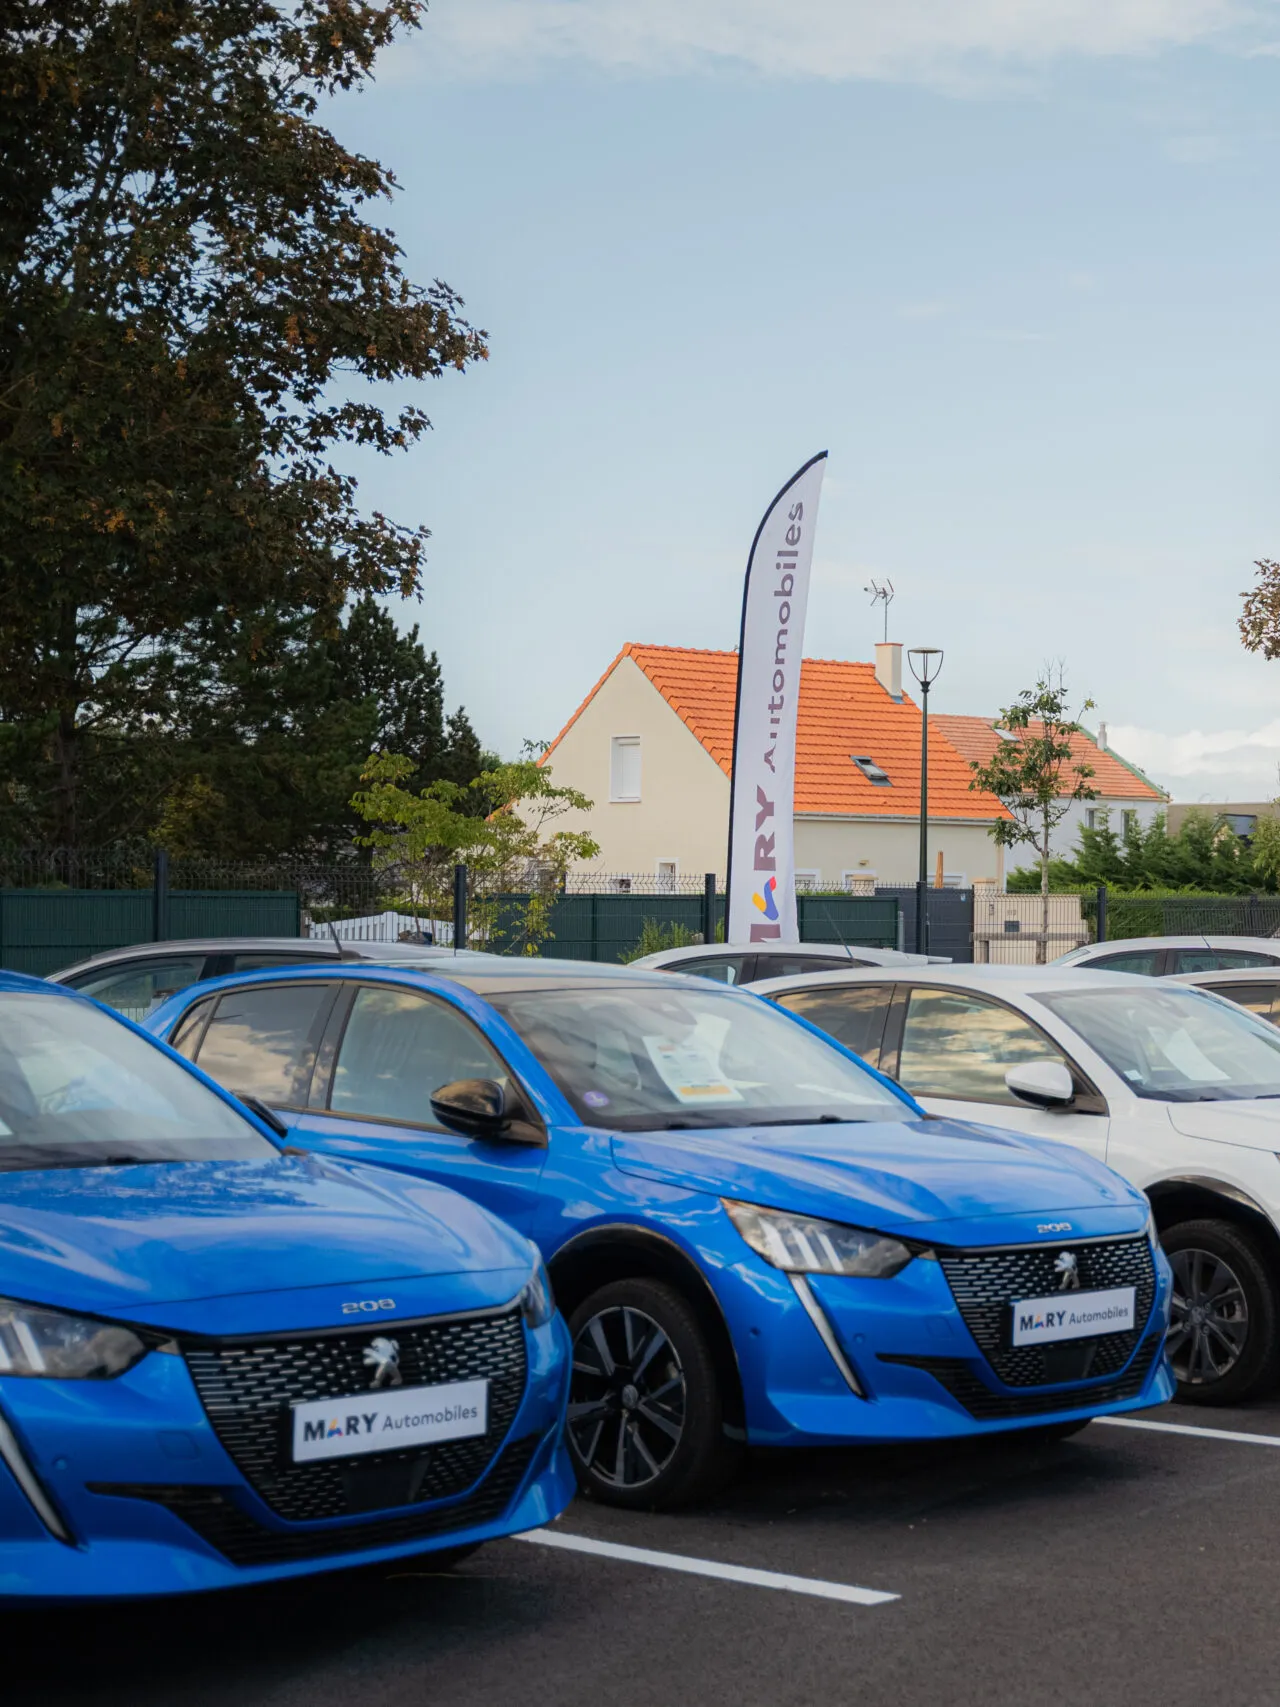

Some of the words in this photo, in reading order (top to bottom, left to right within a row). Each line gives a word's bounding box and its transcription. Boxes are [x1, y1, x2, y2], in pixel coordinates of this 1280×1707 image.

[1036, 1222, 1073, 1234] 208
[341, 1298, 397, 1315] 208
[1019, 1310, 1067, 1332] MARY
[1068, 1306, 1129, 1325] Automobiles
[303, 1412, 379, 1442] MARY
[382, 1404, 478, 1432] Automobiles
